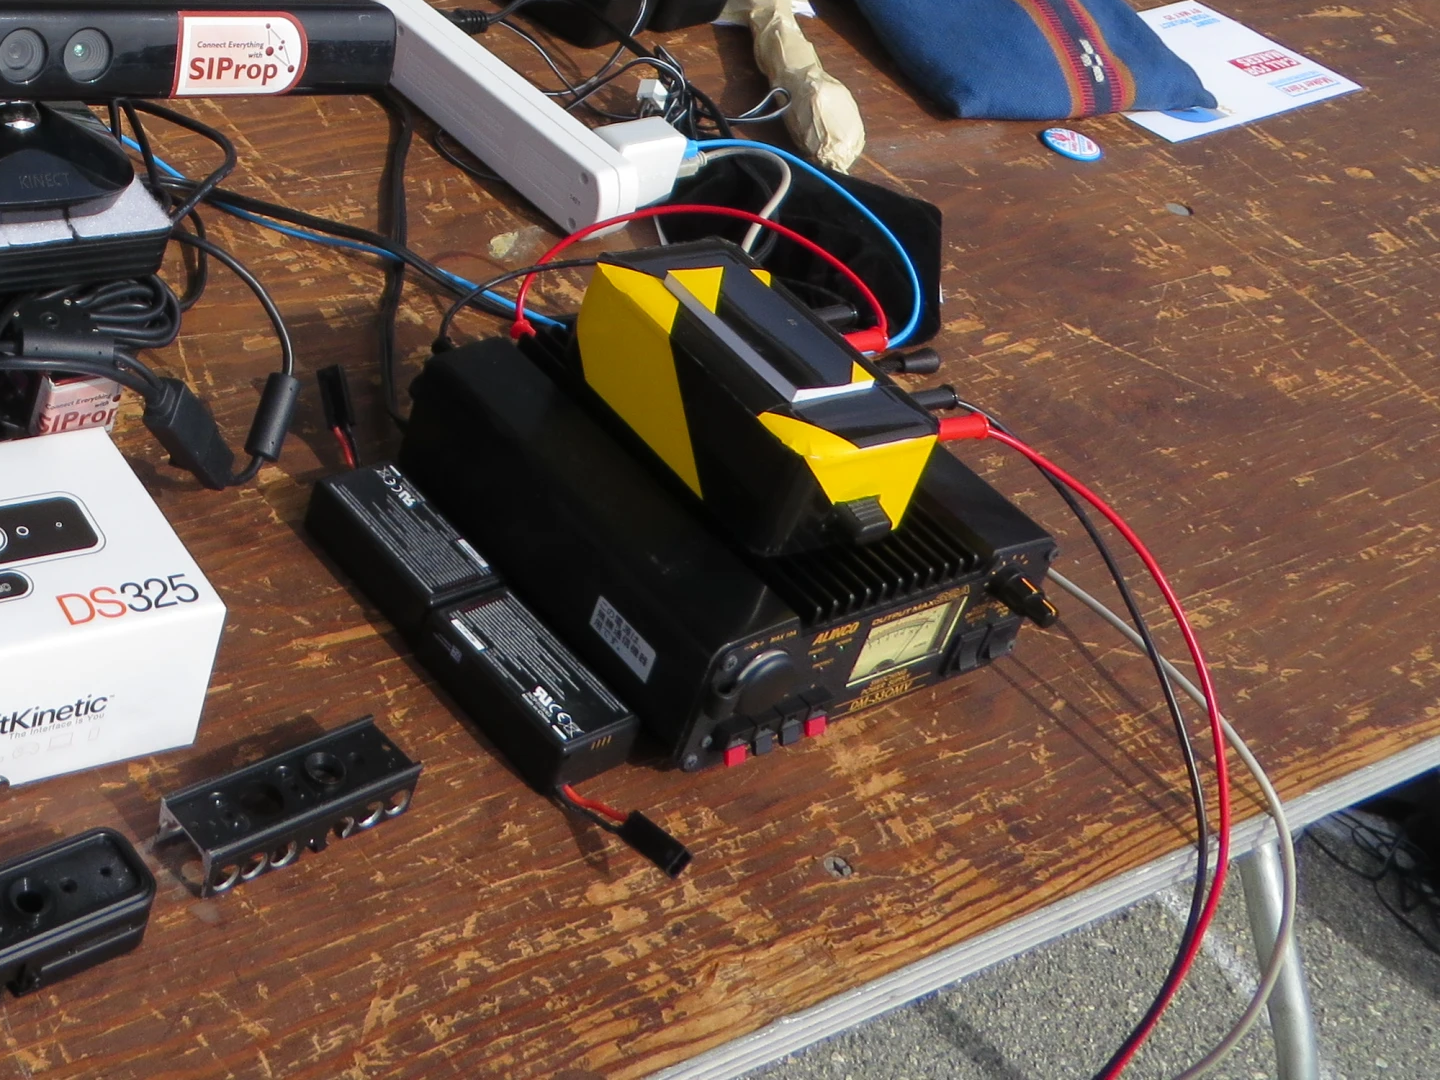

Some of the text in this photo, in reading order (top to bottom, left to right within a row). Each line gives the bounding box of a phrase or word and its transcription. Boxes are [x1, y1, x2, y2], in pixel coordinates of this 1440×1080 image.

[197, 40, 265, 50] Connect Everything
[248, 51, 263, 59] with
[188, 56, 279, 86] SIProp
[18, 172, 70, 190] KINECT
[56, 573, 199, 626] DS325
[812, 621, 860, 646] ALINCO
[9, 731, 27, 741] The
[29, 721, 72, 736] Interface
[87, 712, 106, 723] You
